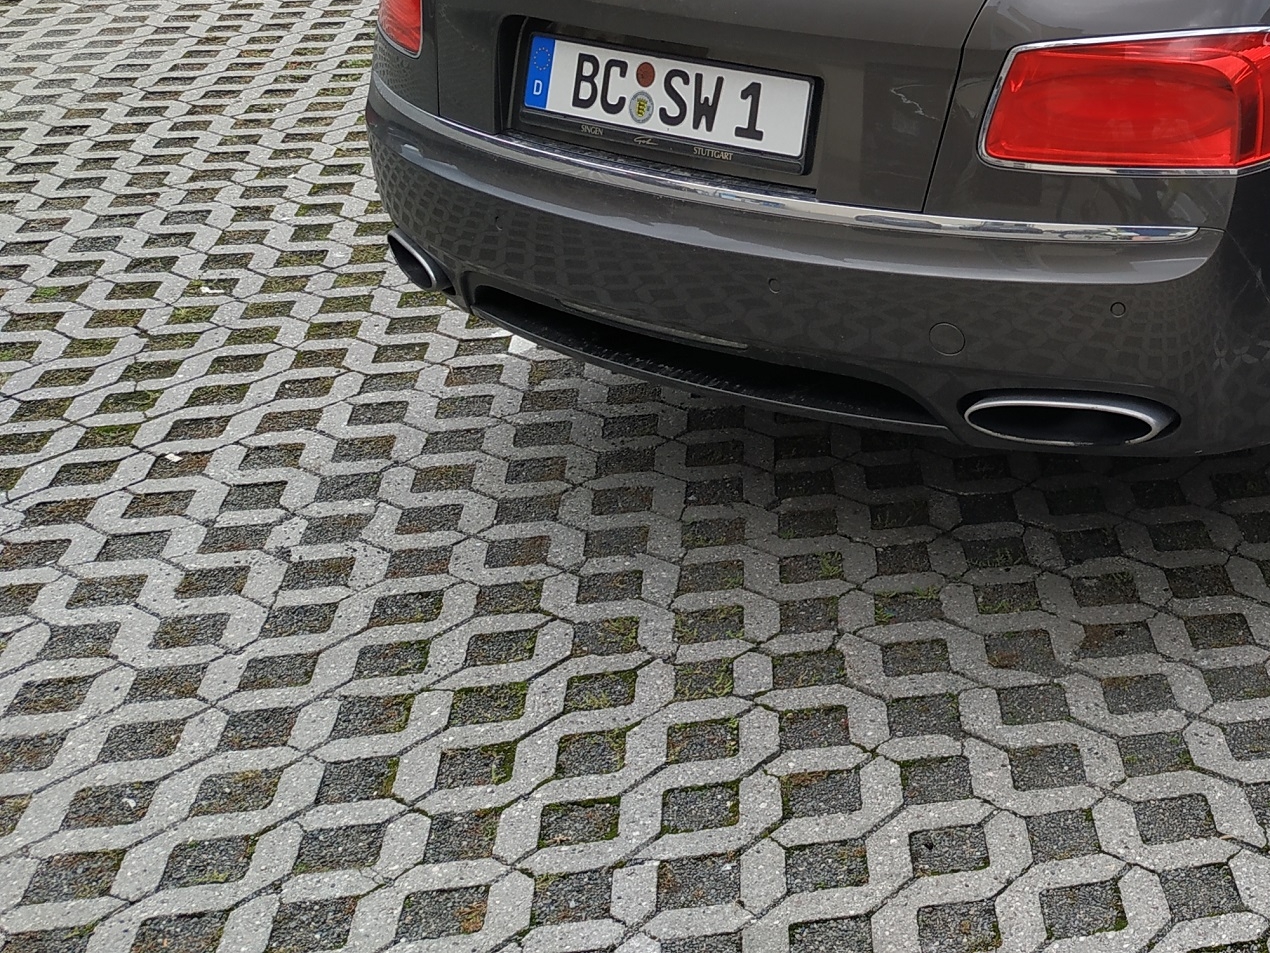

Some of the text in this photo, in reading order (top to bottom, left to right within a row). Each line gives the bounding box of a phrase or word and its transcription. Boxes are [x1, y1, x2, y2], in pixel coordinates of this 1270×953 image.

[533, 80, 543, 95] D
[571, 52, 628, 115] BC
[658, 68, 725, 133] SW
[734, 81, 764, 141] 1
[581, 124, 604, 136] SINGEN
[693, 146, 734, 161] STUTTGART
